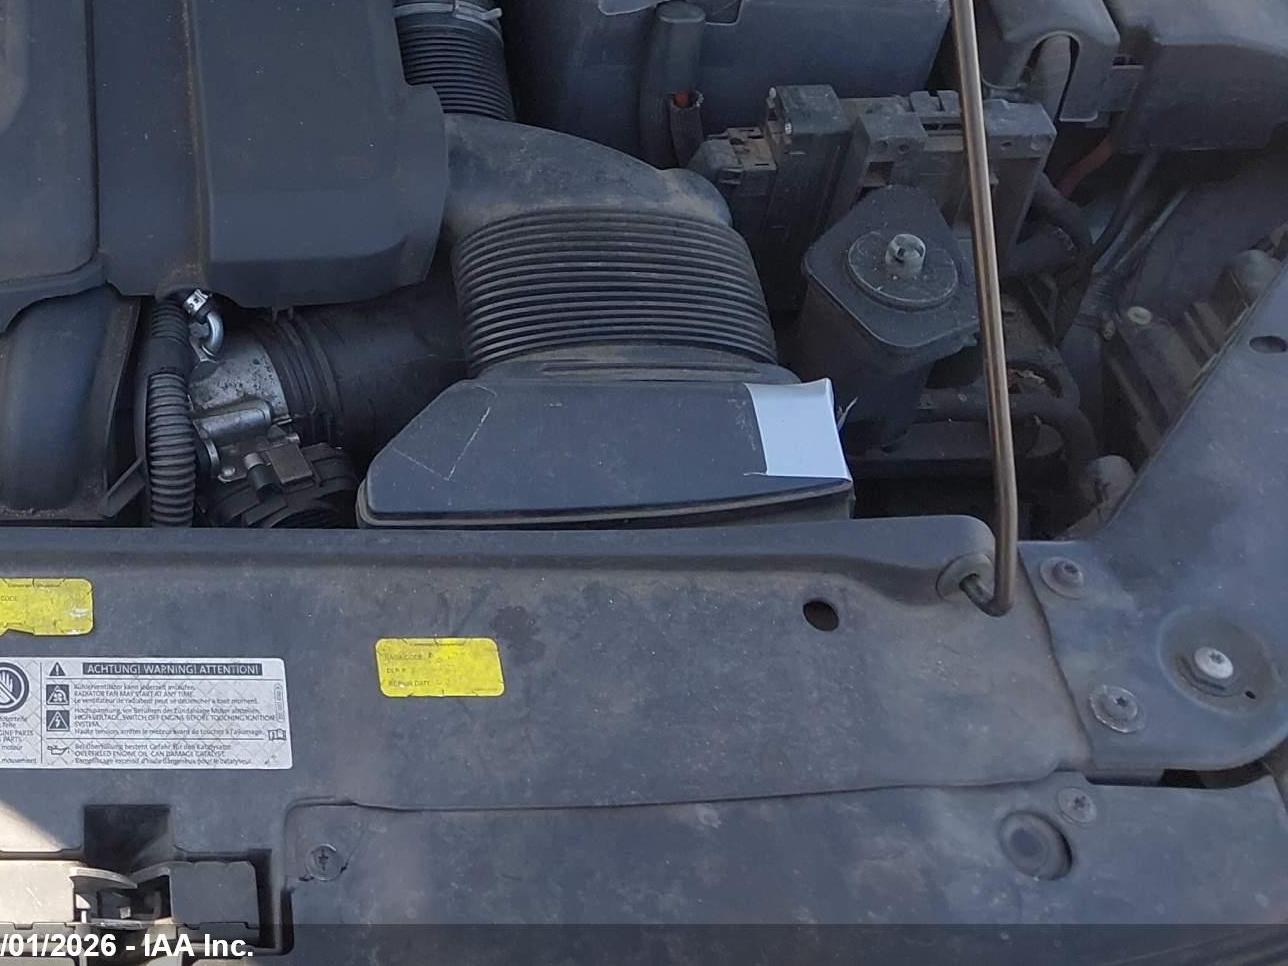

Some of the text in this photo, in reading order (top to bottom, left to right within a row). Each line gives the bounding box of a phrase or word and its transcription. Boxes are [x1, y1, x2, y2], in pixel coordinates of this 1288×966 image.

[87, 664, 258, 674] ACHTUNG! WARNING! ATTENTION!
